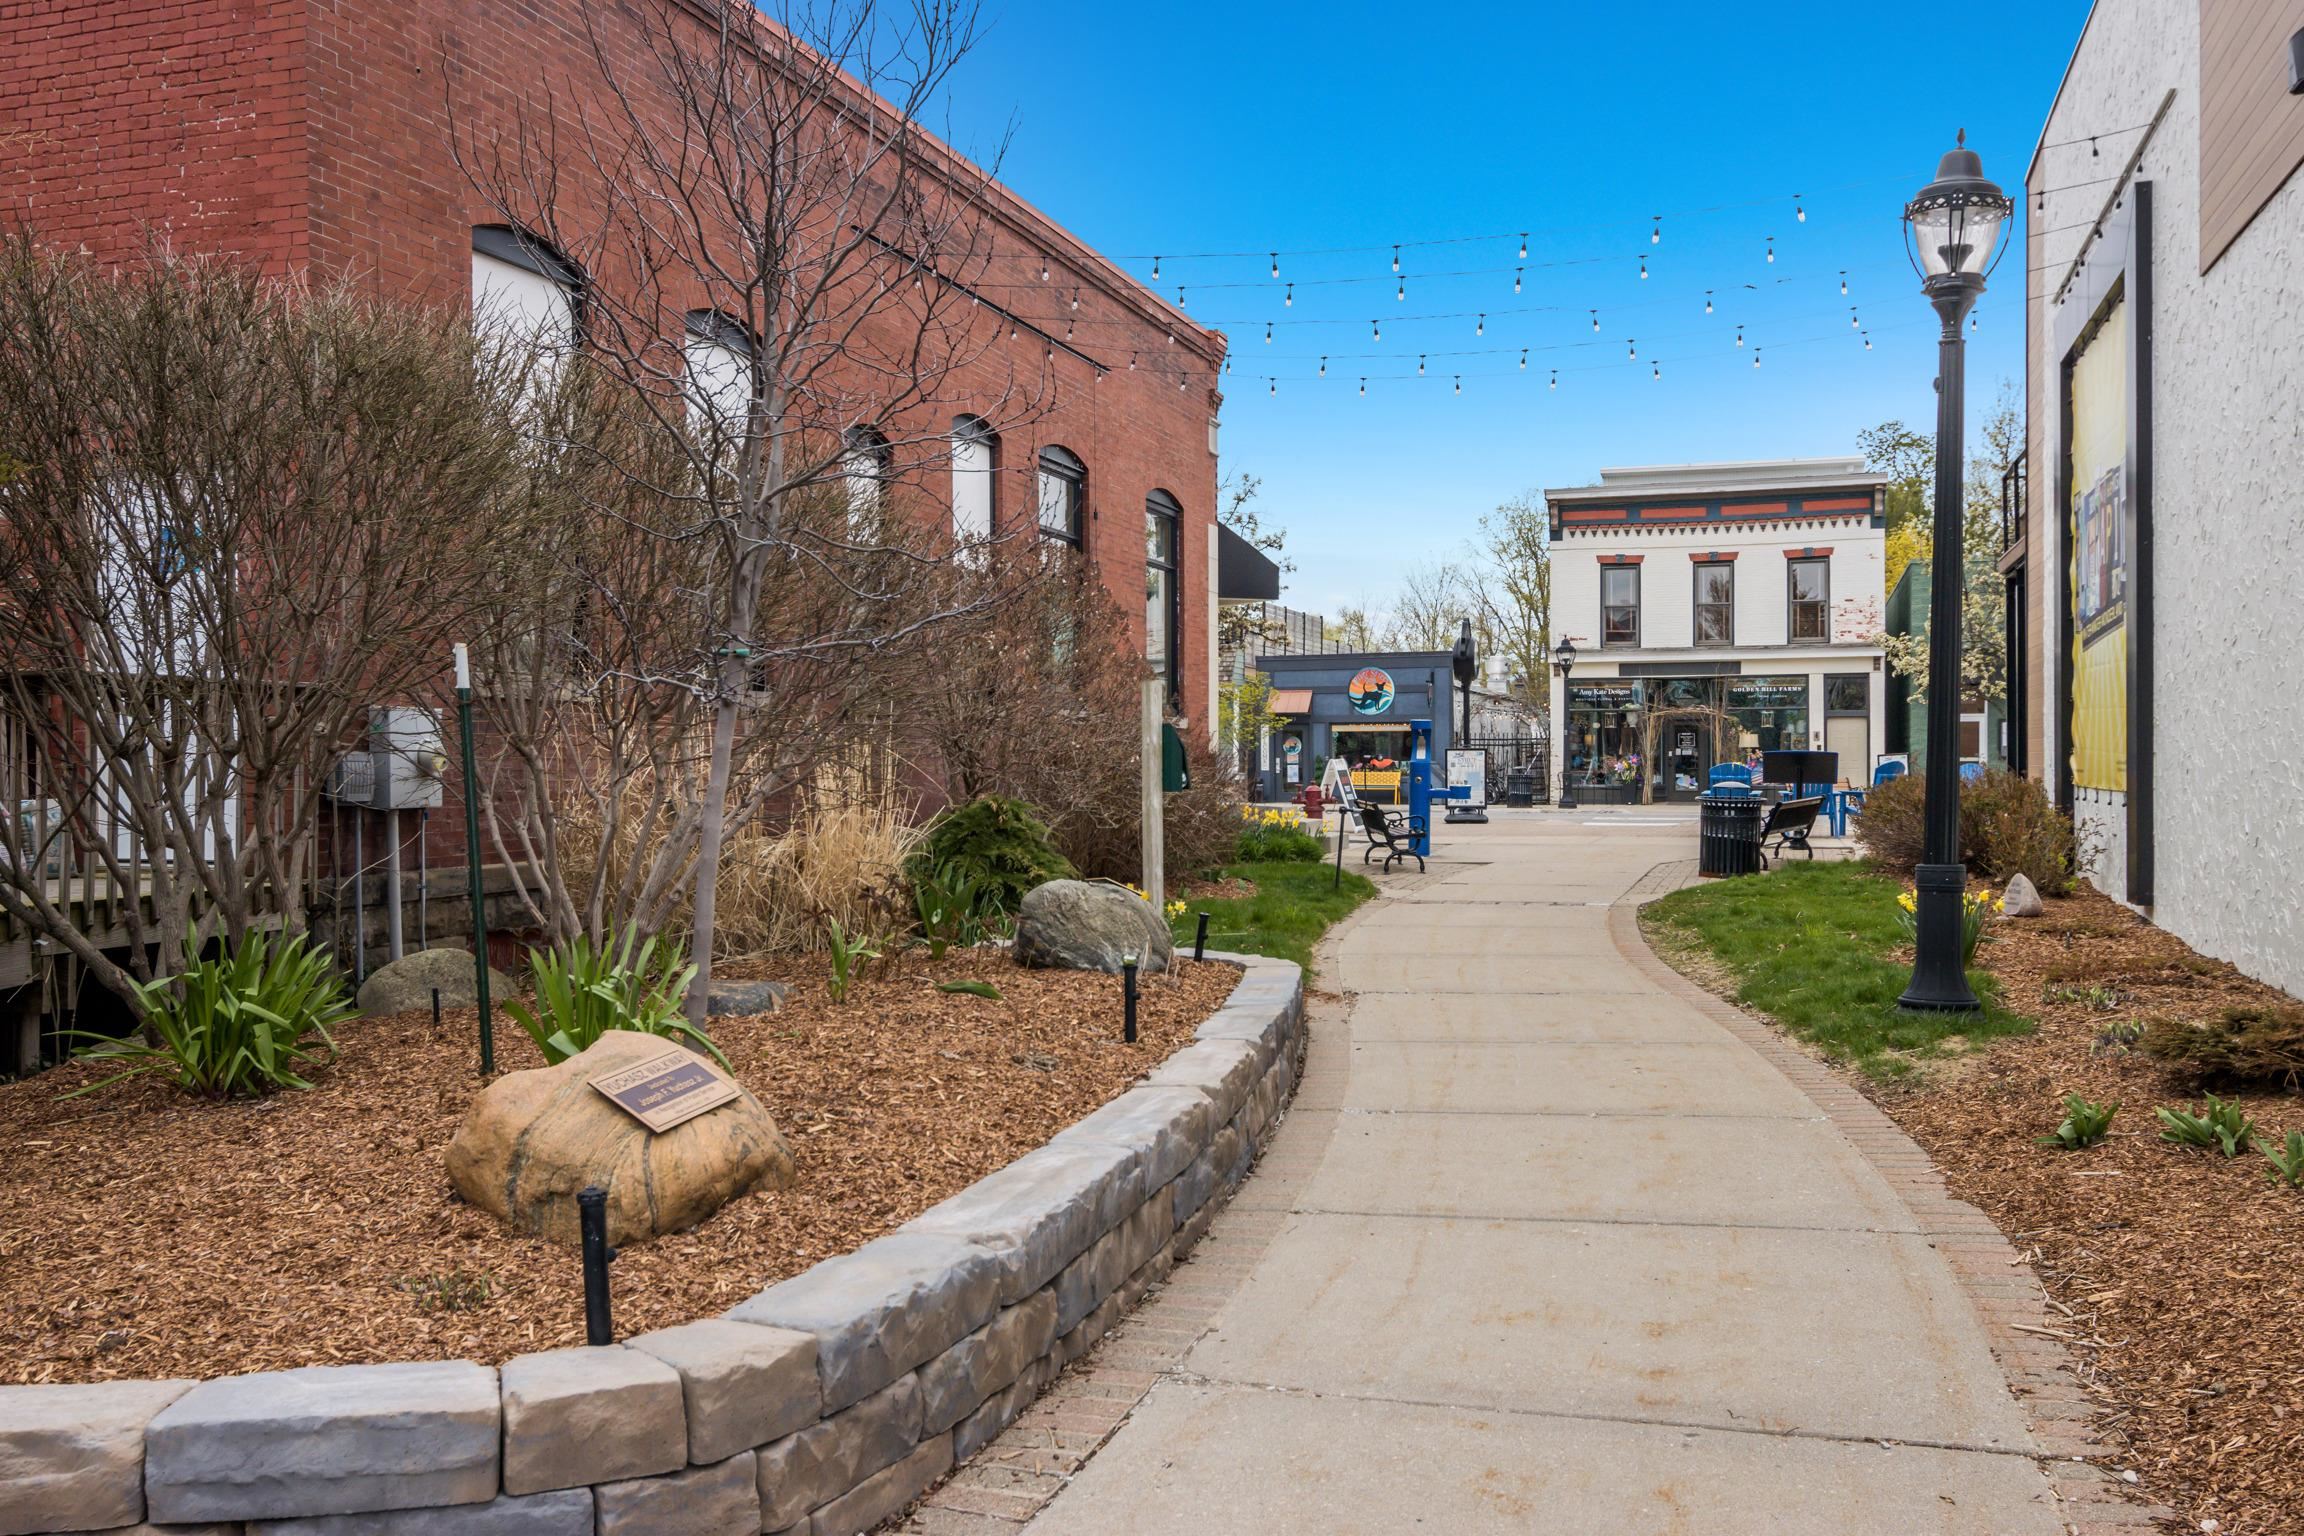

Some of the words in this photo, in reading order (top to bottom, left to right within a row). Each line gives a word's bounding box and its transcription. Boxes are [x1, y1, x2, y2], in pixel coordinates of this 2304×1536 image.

[1579, 688, 1593, 696] Amy
[1608, 688, 1631, 696] Designs
[646, 1054, 686, 1075] WALKWAY
